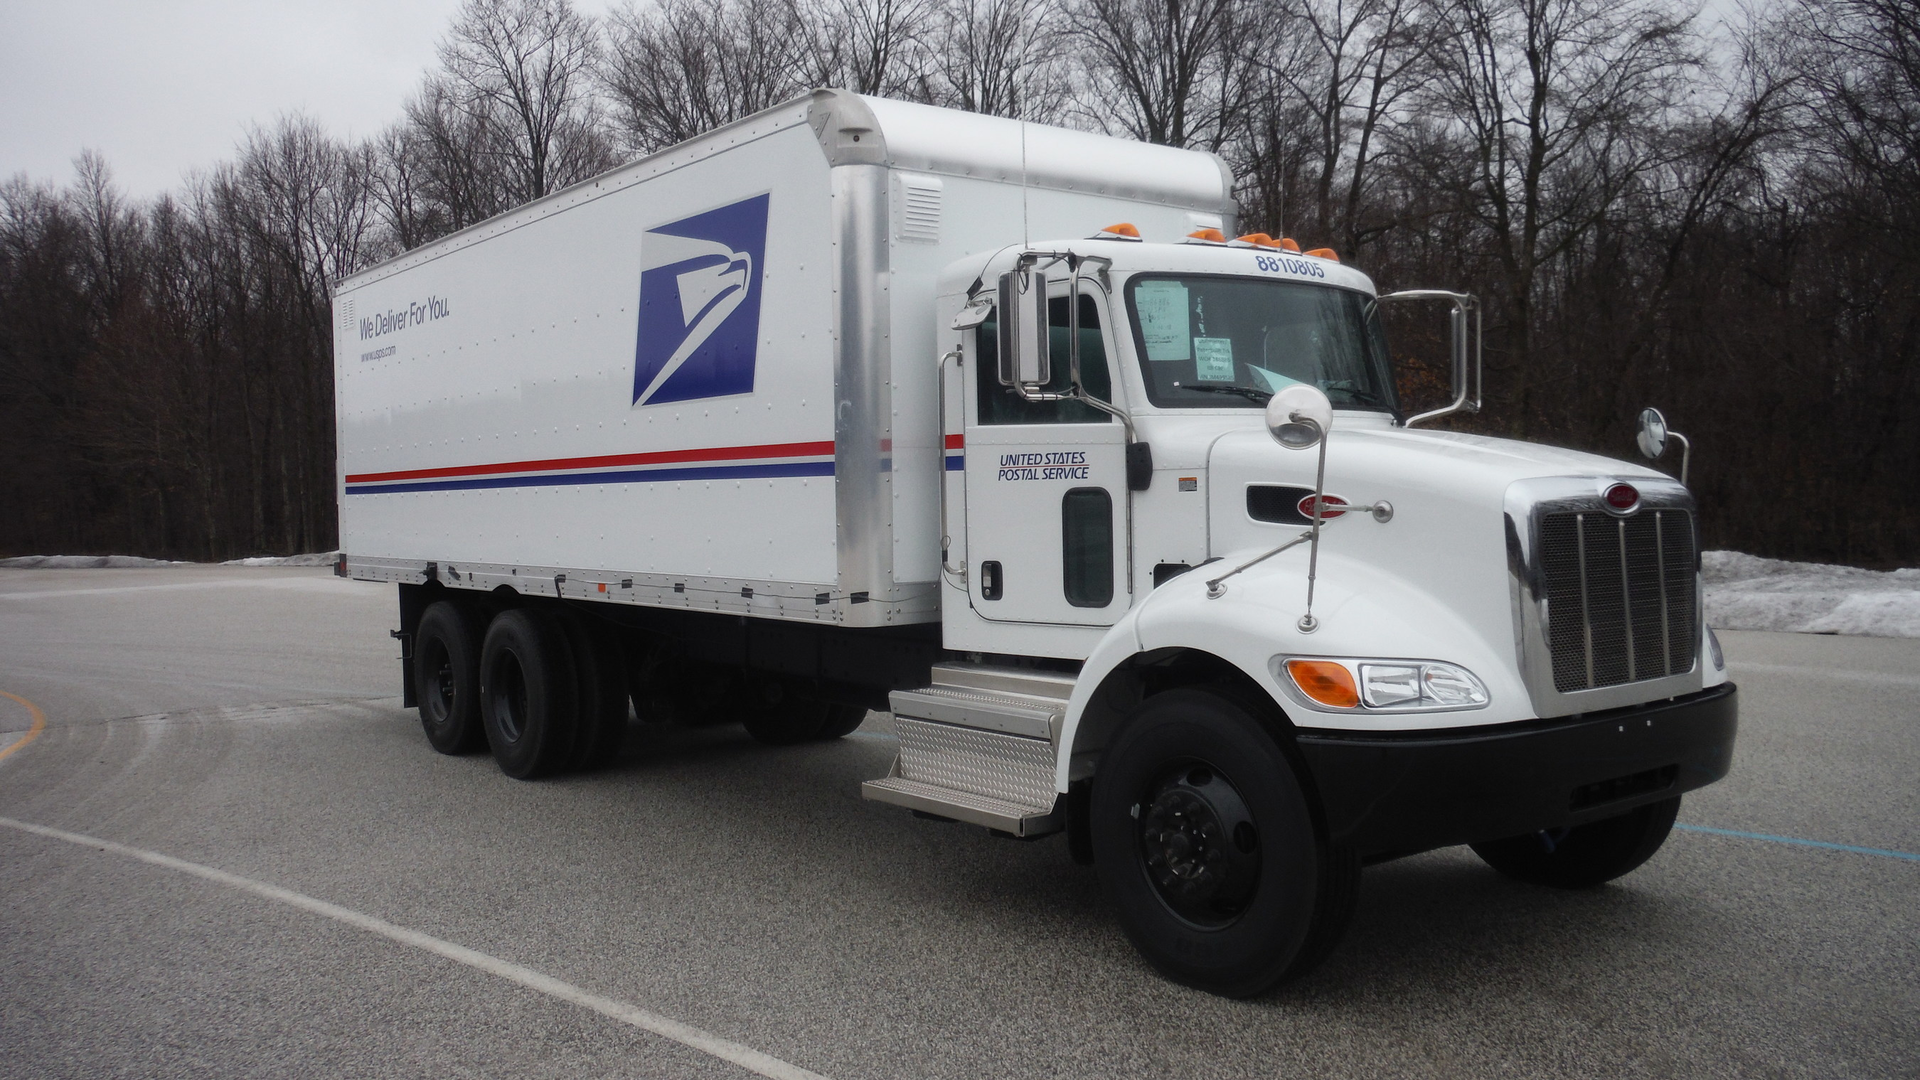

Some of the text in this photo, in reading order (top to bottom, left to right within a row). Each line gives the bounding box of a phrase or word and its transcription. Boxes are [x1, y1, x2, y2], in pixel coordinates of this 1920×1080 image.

[1255, 255, 1325, 278] 8810805
[360, 296, 449, 341] We Deliver For You.
[1000, 451, 1086, 466] UNITED STATES
[998, 466, 1090, 481] POSTAL SERVICE
